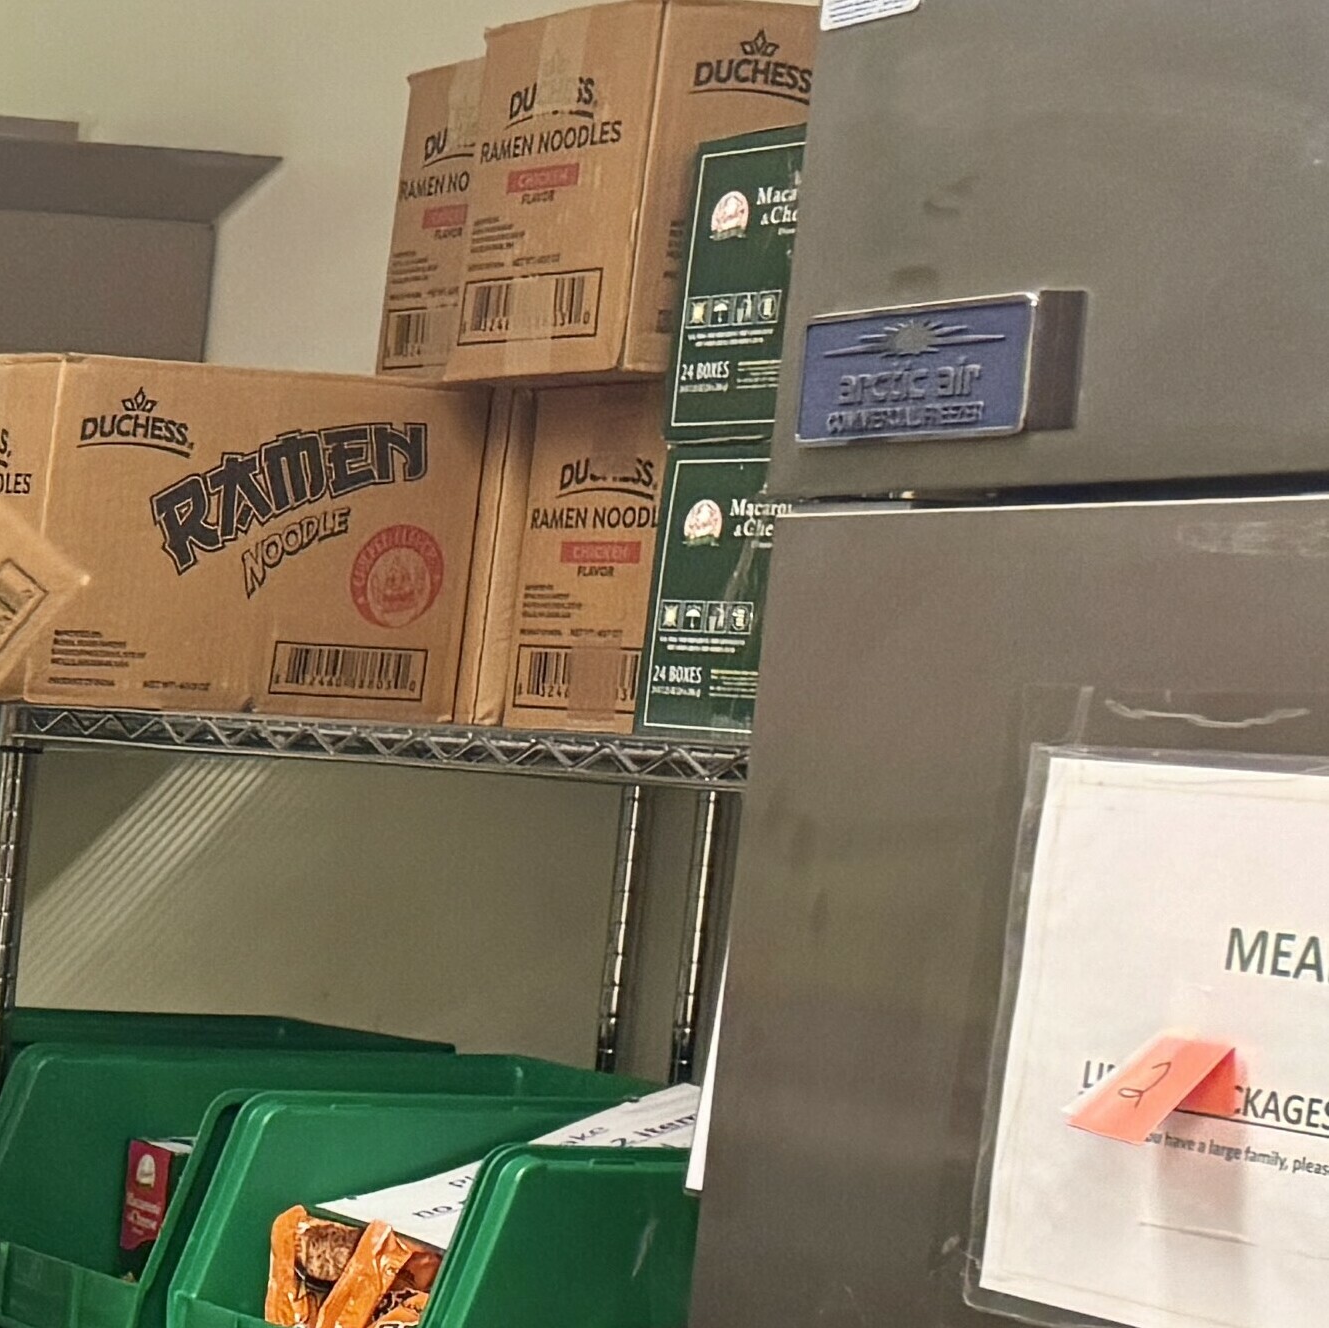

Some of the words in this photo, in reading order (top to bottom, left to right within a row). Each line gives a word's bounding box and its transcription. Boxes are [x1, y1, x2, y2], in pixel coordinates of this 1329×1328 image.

[695, 60, 812, 95] DUCHESS
[480, 133, 534, 164] RAMEN
[537, 120, 623, 150] NOODLES
[399, 174, 445, 202] RAMEN
[681, 363, 700, 381] 24
[702, 361, 730, 380] BOXES
[838, 360, 929, 406] arctic
[936, 356, 983, 398] air
[81, 414, 191, 447] DUCHESS
[151, 423, 428, 575] RAMEN
[530, 506, 588, 530] RAMEN
[242, 507, 351, 599] NOODLE
[653, 665, 666, 682] 24
[668, 665, 702, 685] BOXES
[1224, 927, 1325, 983] MEA
[1165, 1132, 1194, 1151] have
[1198, 1142, 1206, 1154] a
[1209, 1140, 1242, 1162] large
[1244, 1146, 1289, 1171] family,
